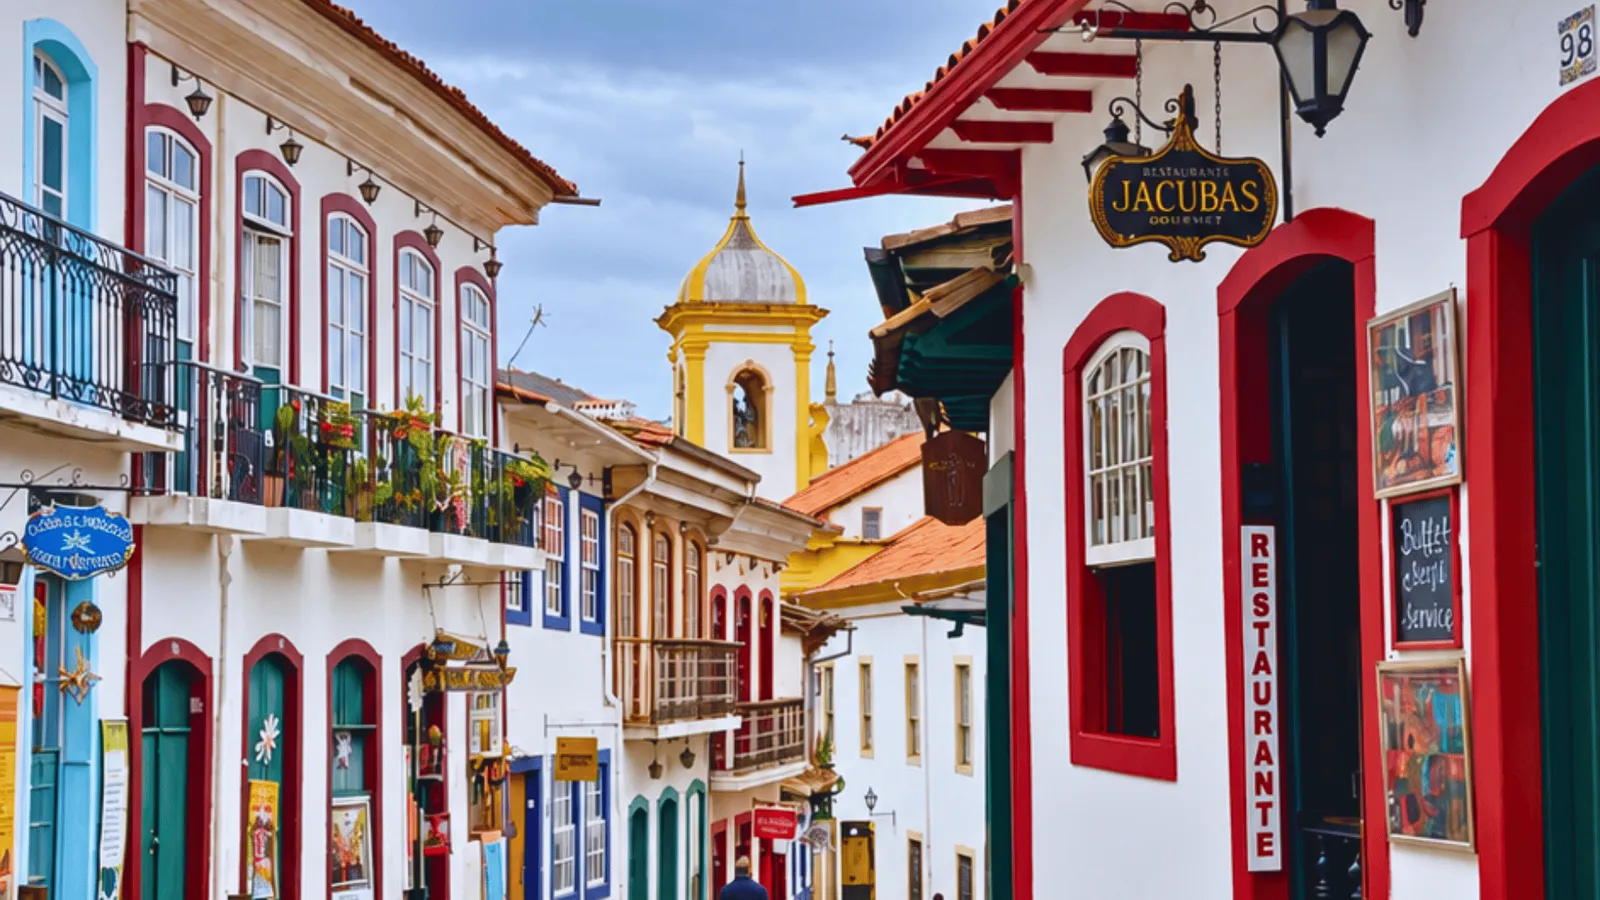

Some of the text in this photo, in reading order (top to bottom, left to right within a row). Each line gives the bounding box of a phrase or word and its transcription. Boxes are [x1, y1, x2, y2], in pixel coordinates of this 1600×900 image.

[1561, 24, 1592, 68] 98
[1142, 167, 1230, 178] RESTAURANTE
[1111, 180, 1260, 213] JACUBAS
[1400, 516, 1451, 558] Buffet
[1250, 532, 1275, 858] RESTAURANTE
